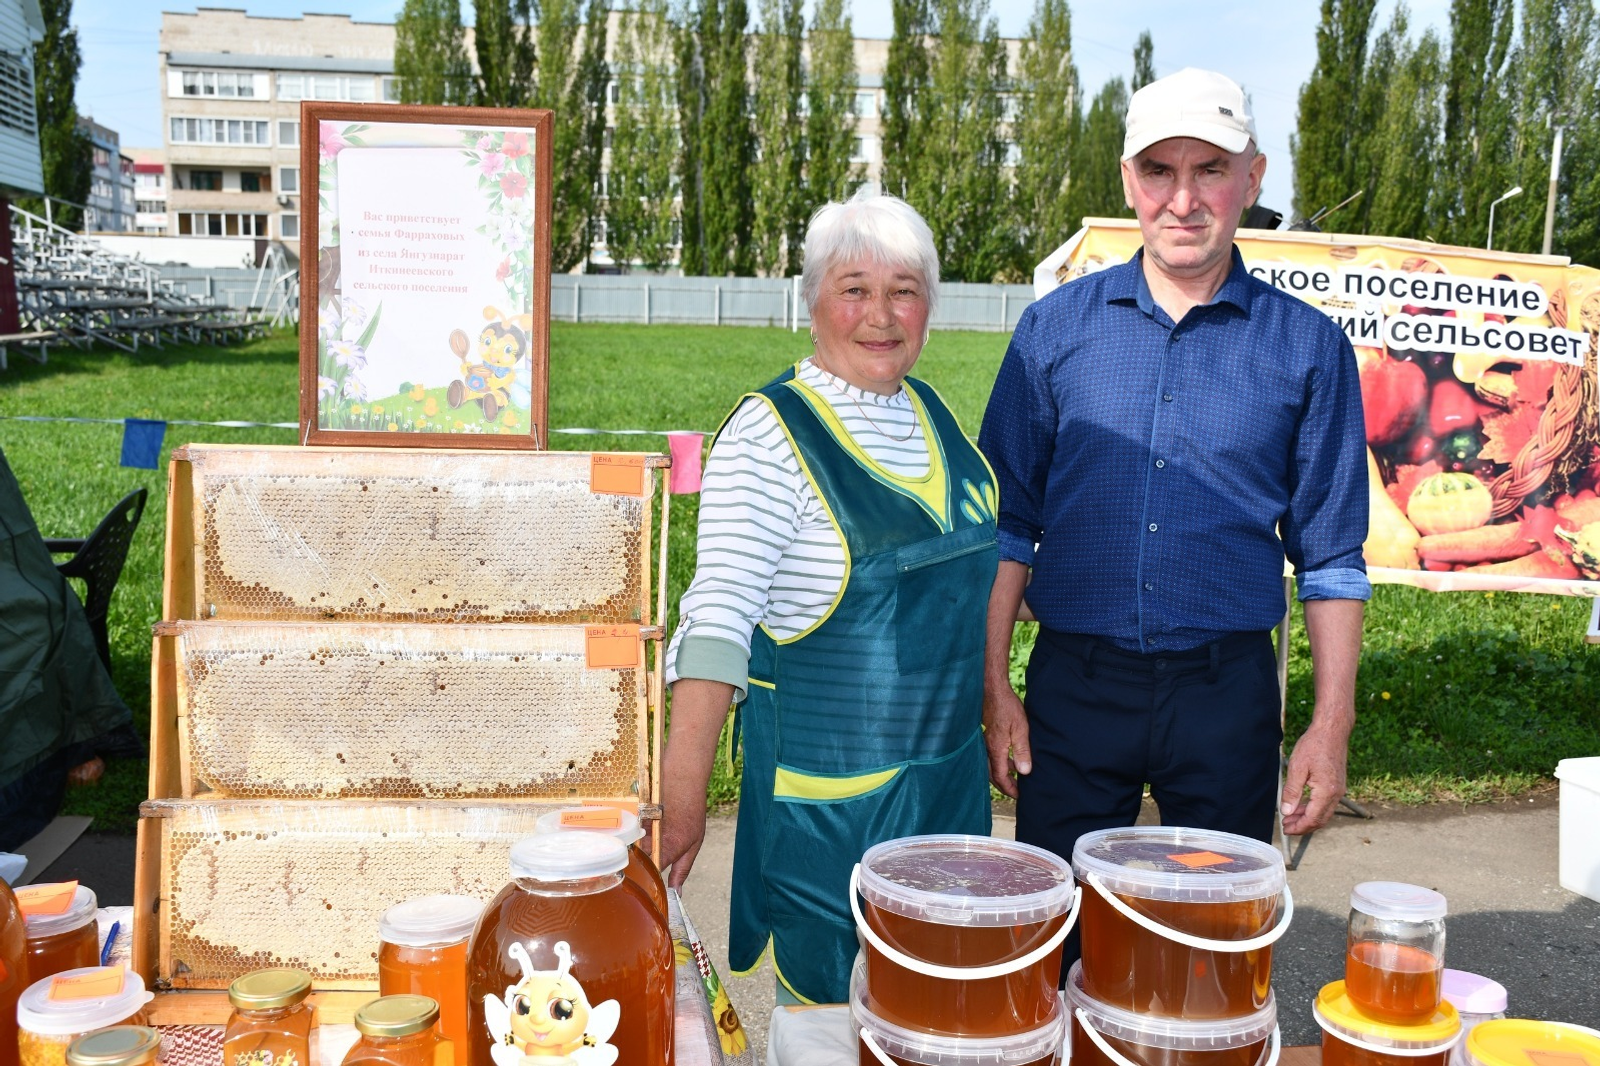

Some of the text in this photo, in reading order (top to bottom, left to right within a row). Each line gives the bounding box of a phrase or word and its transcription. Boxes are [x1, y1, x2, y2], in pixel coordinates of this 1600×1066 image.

[364, 211, 461, 226] Вас приветствует
[358, 228, 465, 241] семья Фарраховых
[358, 249, 370, 258] из
[373, 250, 397, 259] села
[353, 281, 468, 294] сельского поселения
[1344, 272, 1541, 311] поселение
[1330, 309, 1583, 359] ий сельсовет
